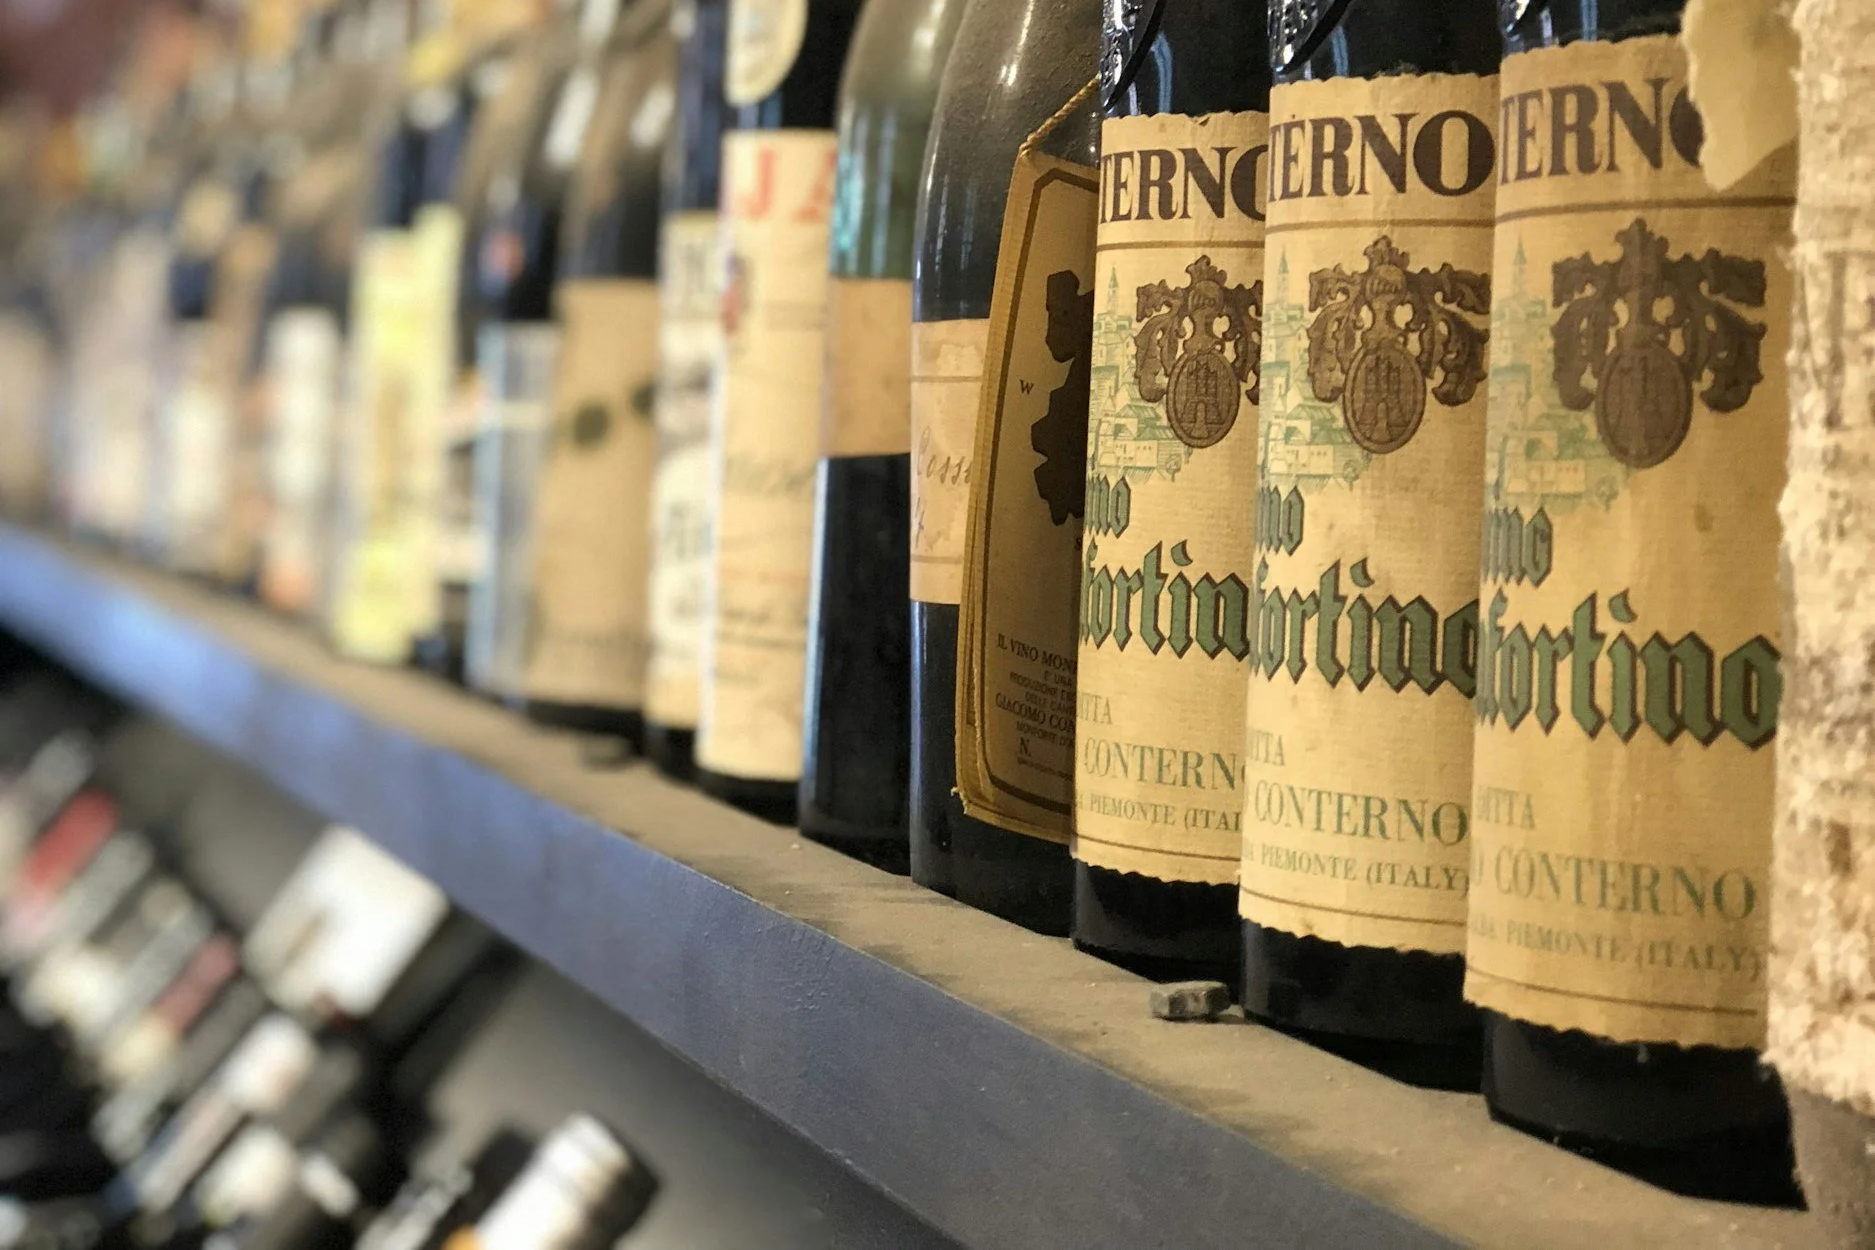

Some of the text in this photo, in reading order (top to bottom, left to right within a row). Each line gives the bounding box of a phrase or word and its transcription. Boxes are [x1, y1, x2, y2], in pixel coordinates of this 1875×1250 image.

[1269, 110, 1495, 202] TERNO
[1019, 379, 1034, 394] W
[1084, 737, 1246, 791] CONTERN
[1089, 792, 1178, 826] PIEMONTE
[1255, 778, 1468, 847] CONTERNO
[1261, 843, 1357, 882] PIEMONTE
[1494, 843, 1757, 922] CONTERNO
[1506, 918, 1626, 963] PIEMONTE
[1634, 940, 1765, 983] (ITALY)
